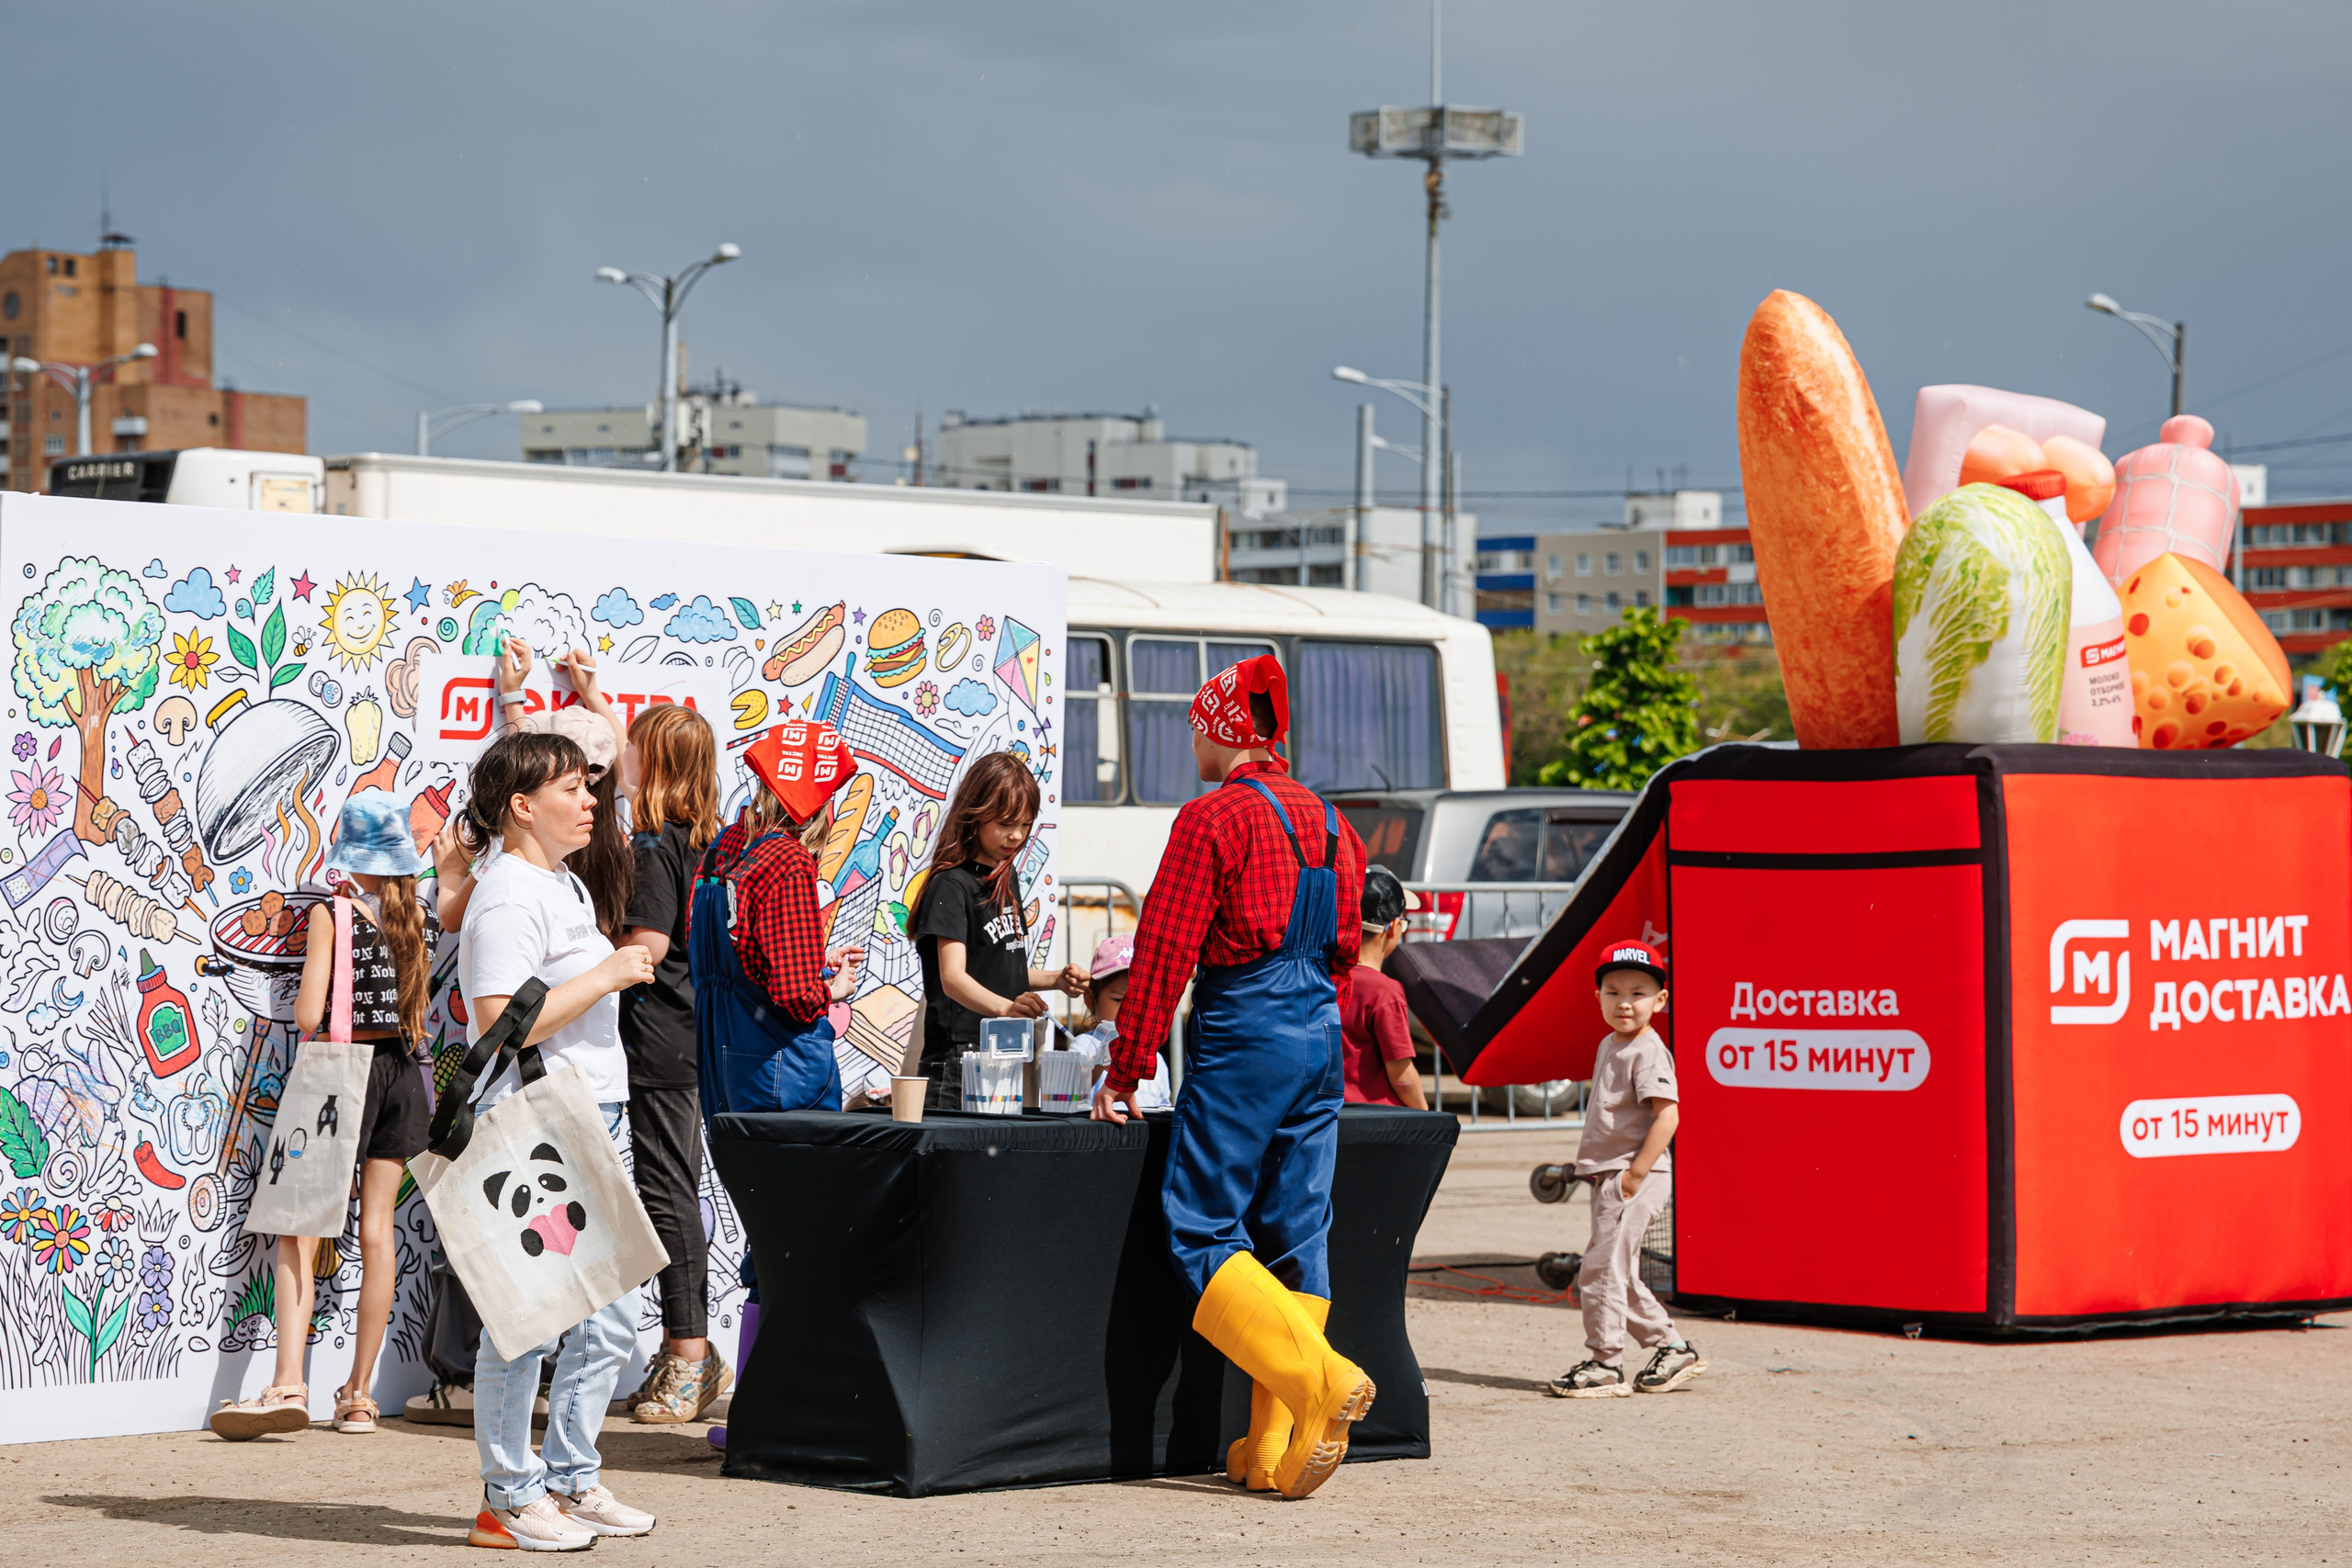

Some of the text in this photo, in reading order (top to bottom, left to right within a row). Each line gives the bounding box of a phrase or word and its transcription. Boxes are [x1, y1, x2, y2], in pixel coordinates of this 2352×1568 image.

[67, 461, 135, 480] CARRIER
[1612, 947, 1651, 965] MARVEL
[2150, 915, 2309, 961] МАГНИТ
[1730, 981, 1900, 1021] Доставка
[2149, 973, 2352, 1032] ДОСТАВКА
[155, 1019, 182, 1043] BBQ
[1718, 1039, 1915, 1083] от 15 минут
[2132, 1109, 2289, 1144] от 15 минут
